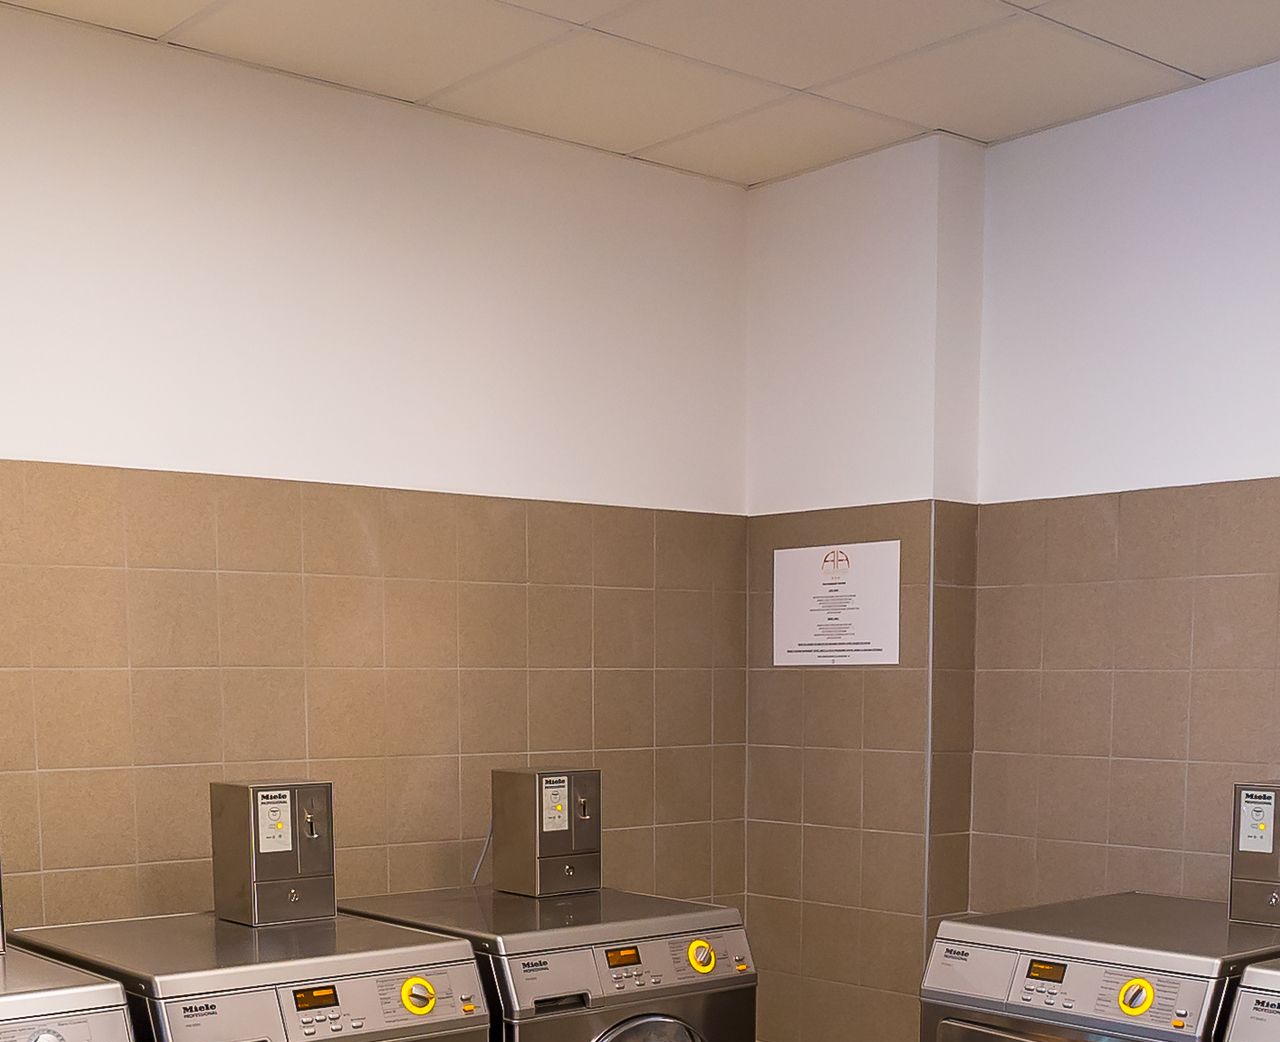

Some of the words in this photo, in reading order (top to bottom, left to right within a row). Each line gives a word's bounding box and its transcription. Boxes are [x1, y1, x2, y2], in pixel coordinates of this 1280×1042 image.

[261, 793, 288, 801] Miele
[945, 948, 970, 957] Miele
[522, 960, 548, 969] Miele
[182, 1004, 216, 1014] Miele
